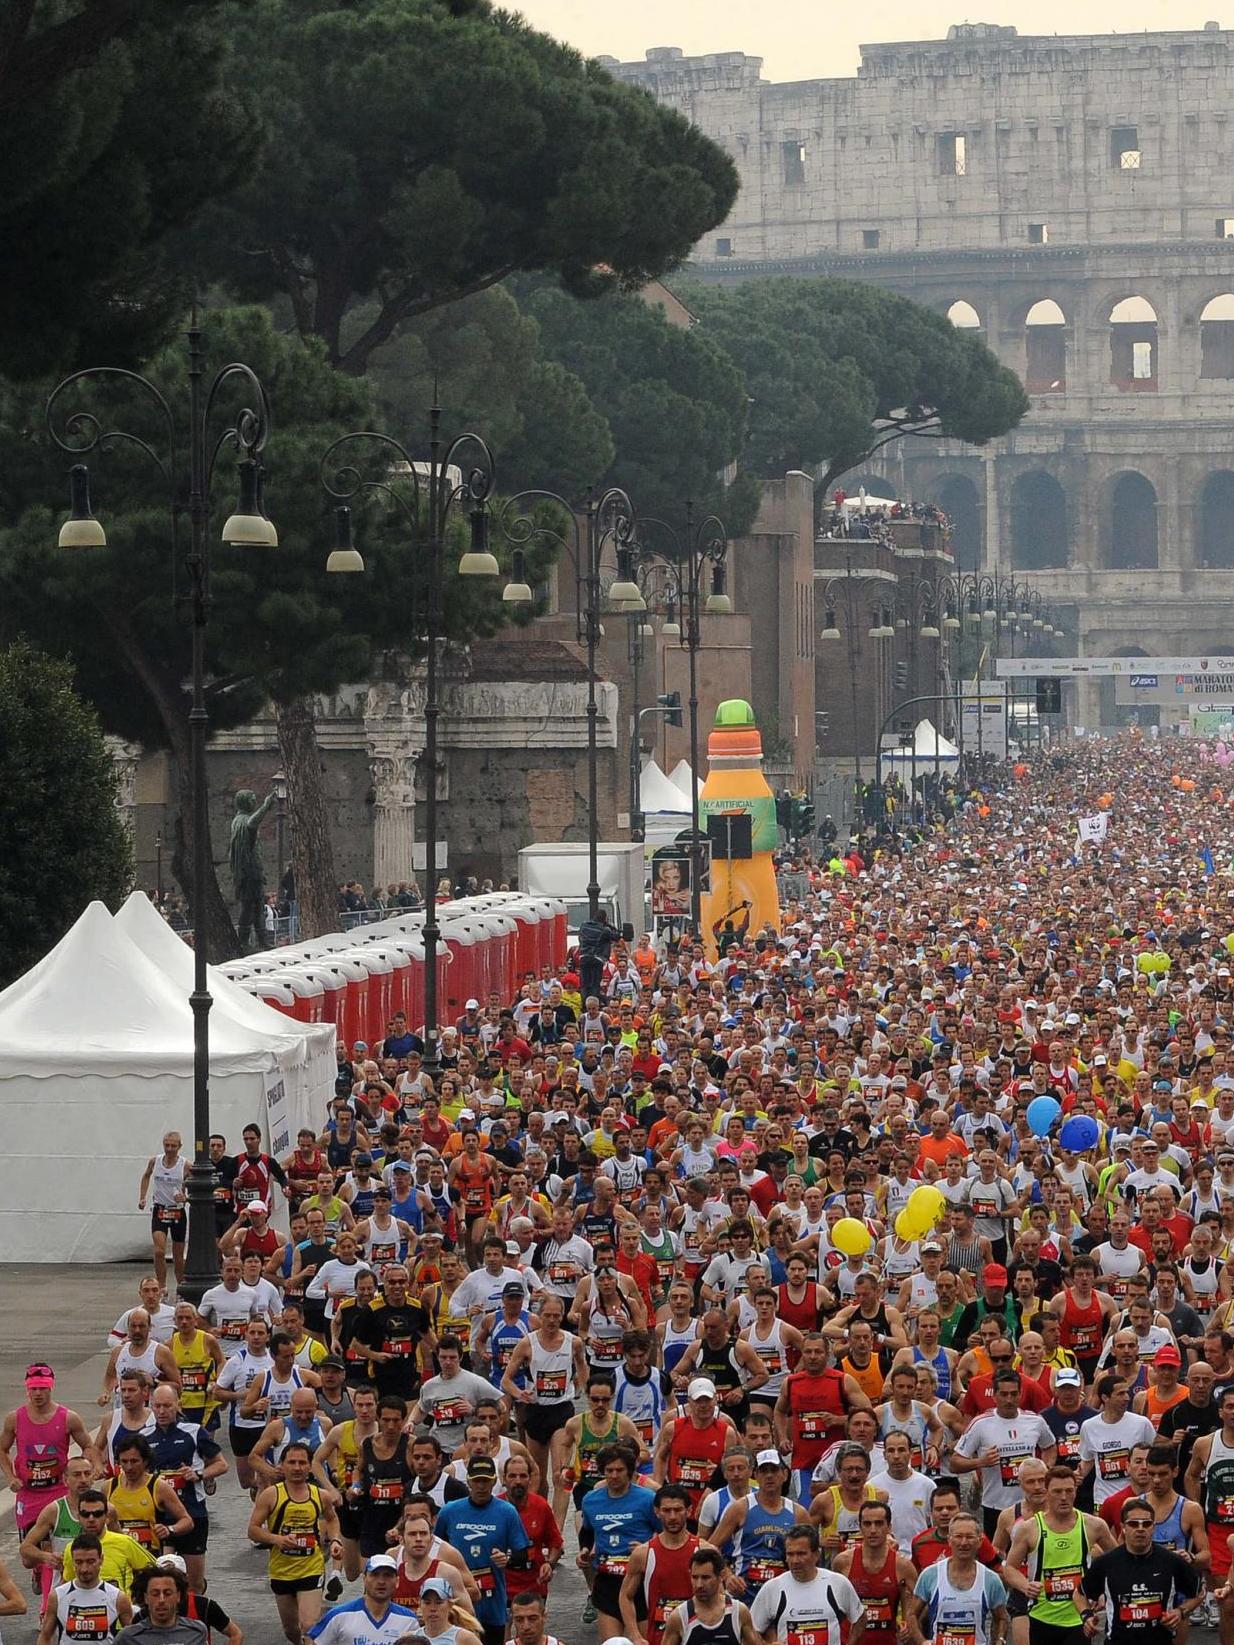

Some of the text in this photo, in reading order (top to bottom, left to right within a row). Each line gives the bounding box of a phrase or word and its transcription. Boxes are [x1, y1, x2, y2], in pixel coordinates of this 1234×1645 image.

[1194, 684, 1233, 694] di ROMA
[715, 800, 755, 808] ARTIFICIAL
[1102, 1440, 1122, 1450] GIORGIO
[32, 1470, 51, 1480] 2152
[595, 1512, 633, 1521] BROOKS
[455, 1523, 497, 1532] BROOKS
[1050, 1579, 1074, 1592] 1535
[1130, 1608, 1149, 1620] 104
[74, 1619, 96, 1632] 609
[798, 1634, 816, 1645] 113
